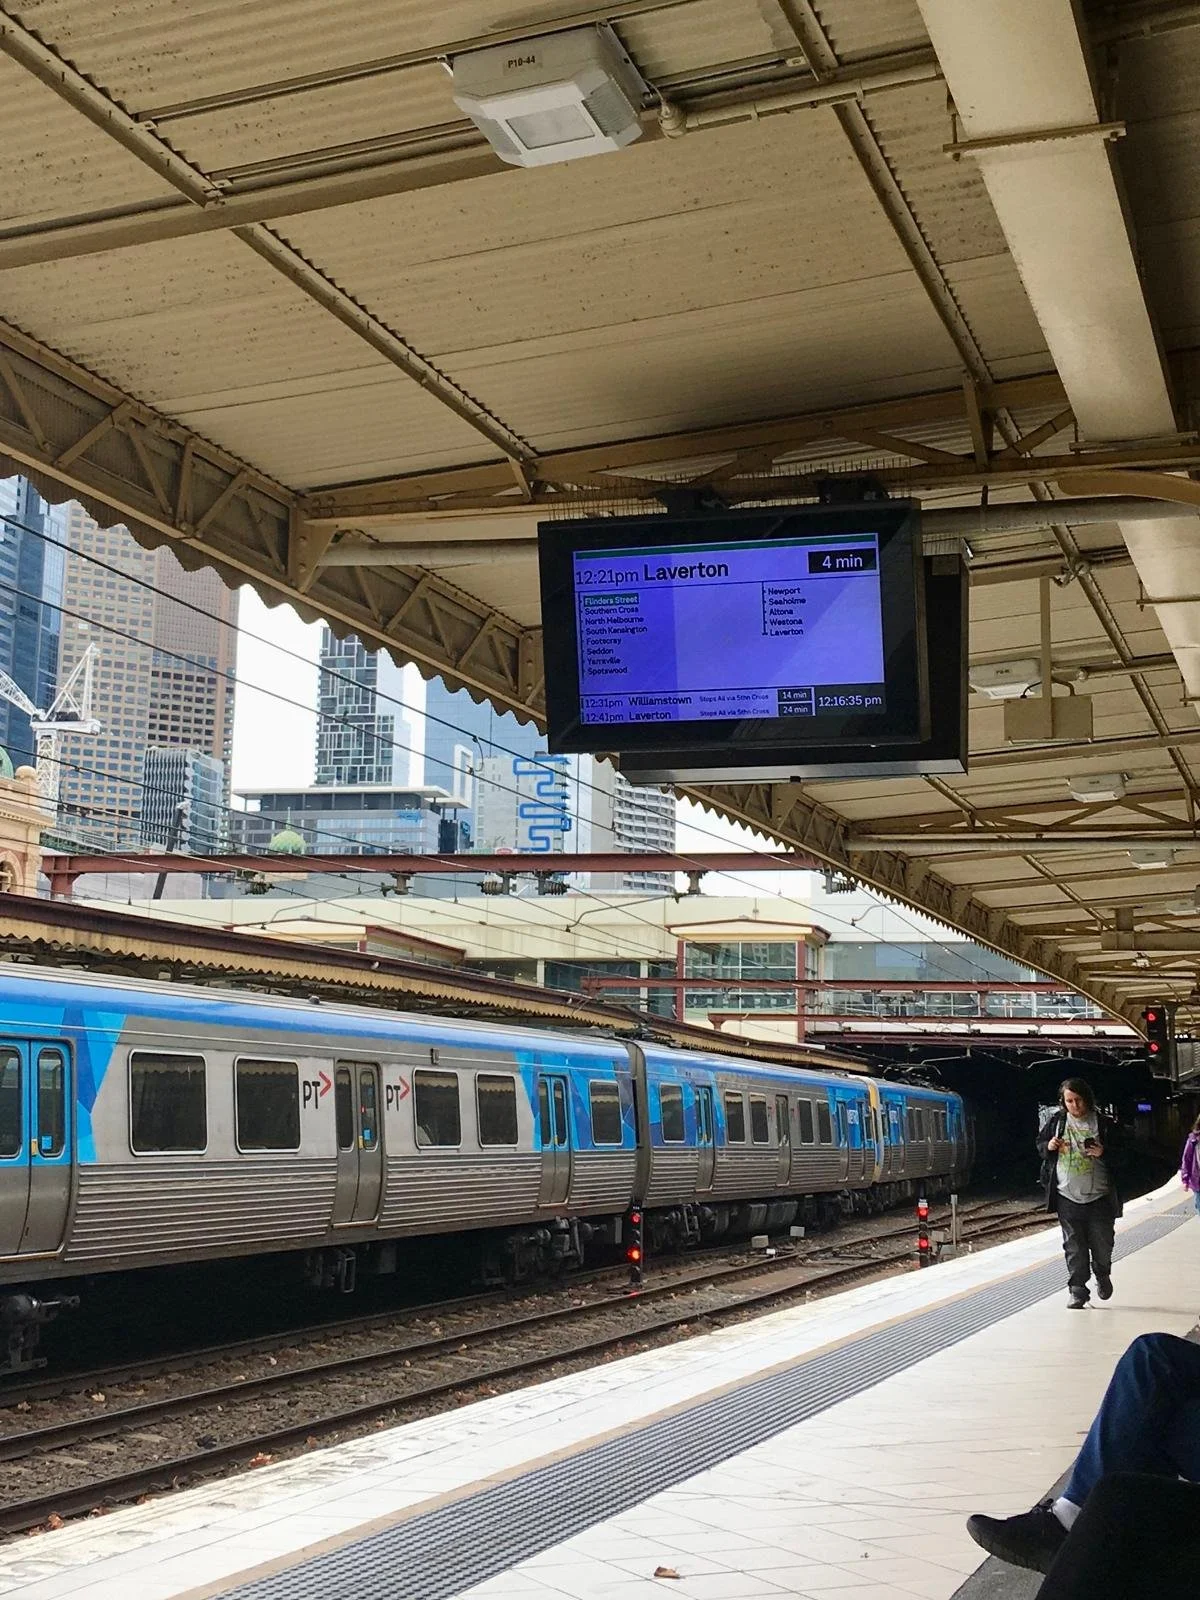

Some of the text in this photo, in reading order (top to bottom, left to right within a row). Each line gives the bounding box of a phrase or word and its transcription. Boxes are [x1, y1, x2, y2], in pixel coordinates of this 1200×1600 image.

[822, 553, 863, 569] 4 min
[576, 562, 729, 586] 12:21pm Laverton
[768, 587, 801, 596] Newport
[615, 596, 638, 604] Street
[768, 597, 807, 606] Seaholme
[585, 606, 639, 615] Southern Cross
[769, 608, 794, 616] Altona
[585, 615, 645, 625] North Melbourne
[769, 618, 803, 626] Westona
[586, 626, 648, 636] South Kensington
[770, 628, 804, 637] Laverton
[586, 638, 622, 646] Footscray
[586, 648, 614, 656] Seddon
[587, 657, 621, 665] Yarraville
[587, 667, 628, 676] Spotswood
[782, 690, 807, 699] 14 min
[585, 699, 623, 709] 12:31pm
[628, 695, 692, 706] Williamstown
[818, 695, 882, 708] 12:16:35 pm
[783, 705, 808, 714] 24 min
[585, 712, 624, 722] 12:41pm
[628, 710, 672, 721] Laverton
[303, 1080, 321, 1110] PT
[386, 1084, 401, 1112] PT
